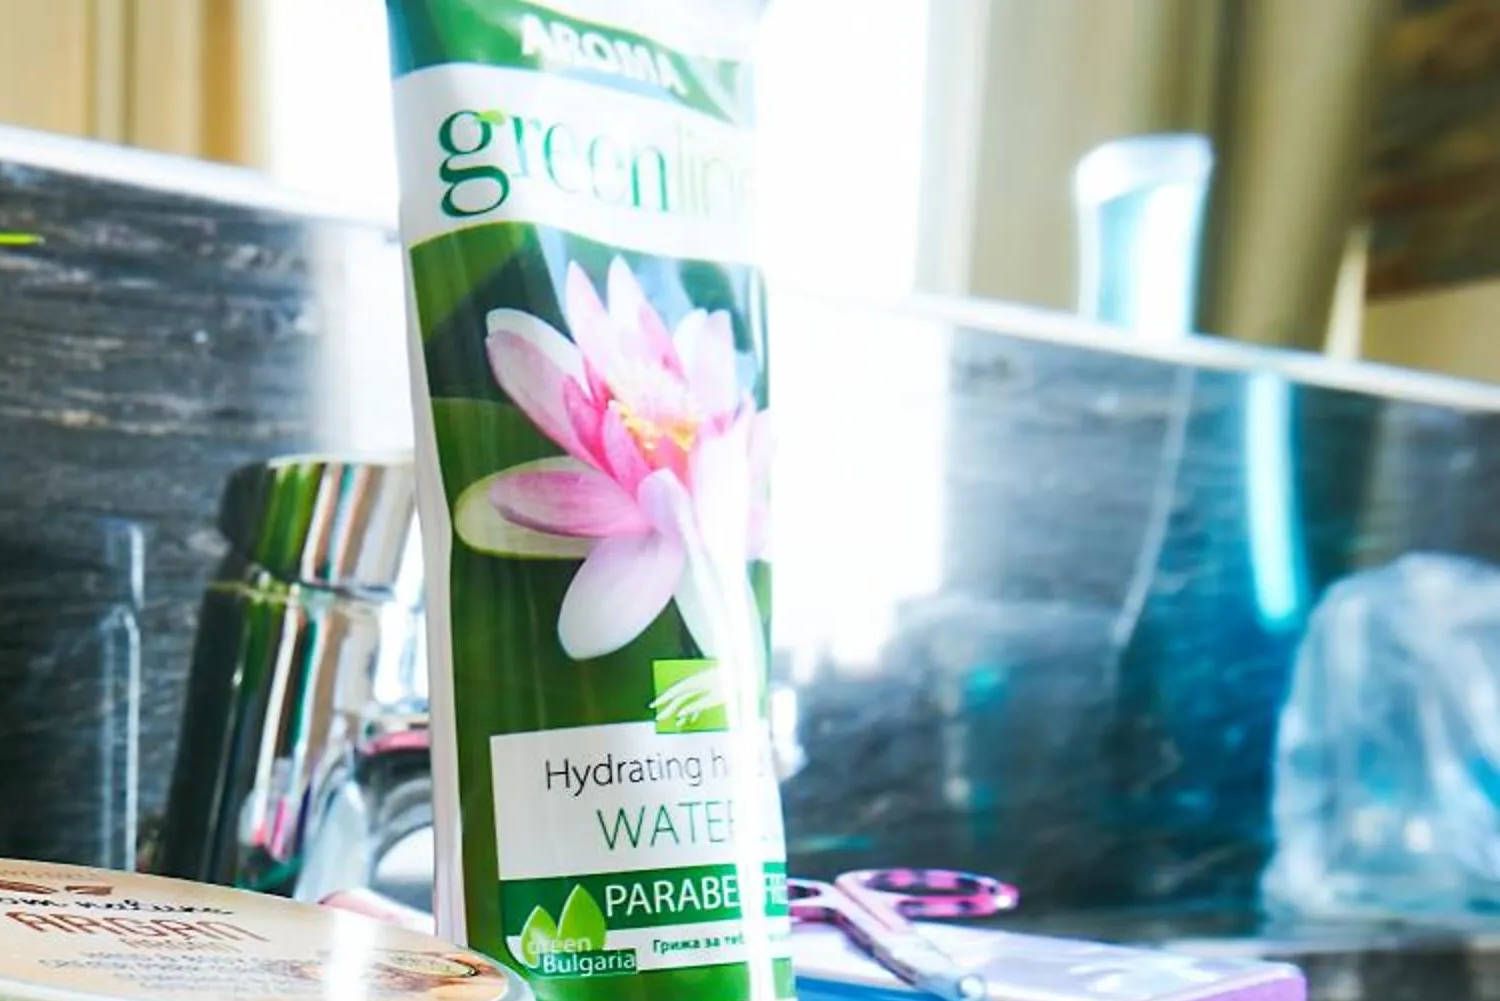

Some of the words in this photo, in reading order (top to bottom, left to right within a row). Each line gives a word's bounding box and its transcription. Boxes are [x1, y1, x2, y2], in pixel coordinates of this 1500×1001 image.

[521, 12, 688, 95] AROMA
[544, 751, 703, 798] Hydrating
[605, 875, 743, 918] PARABE
[543, 952, 637, 976] Bulgaria
[652, 938, 700, 956] Грижа
